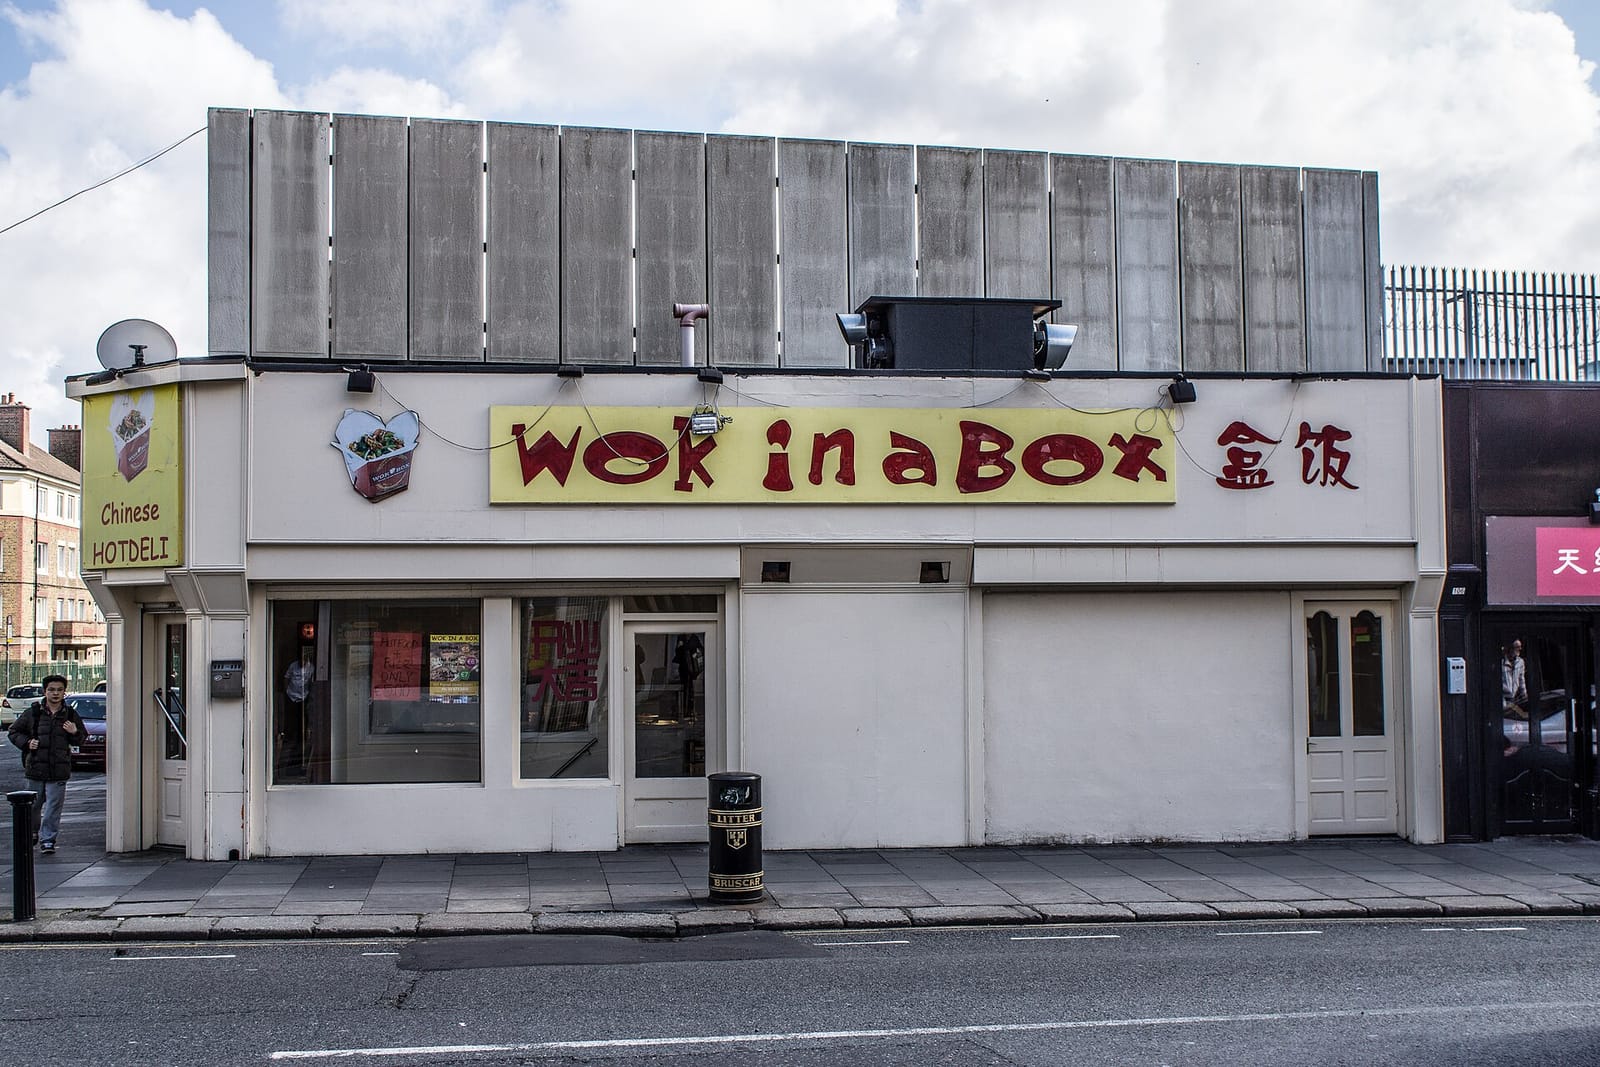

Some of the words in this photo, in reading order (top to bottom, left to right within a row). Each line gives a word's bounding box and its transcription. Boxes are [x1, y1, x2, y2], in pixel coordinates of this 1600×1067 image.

[762, 419, 856, 492] in
[1216, 421, 1360, 491] 盒饭
[372, 471, 391, 482] WOK
[395, 462, 410, 473] BOX
[101, 501, 160, 525] Chinese
[93, 536, 168, 566] HOTDELI
[380, 671, 414, 683] ONLY
[717, 814, 755, 823] LITTER
[714, 877, 761, 887] BRUSCAR
